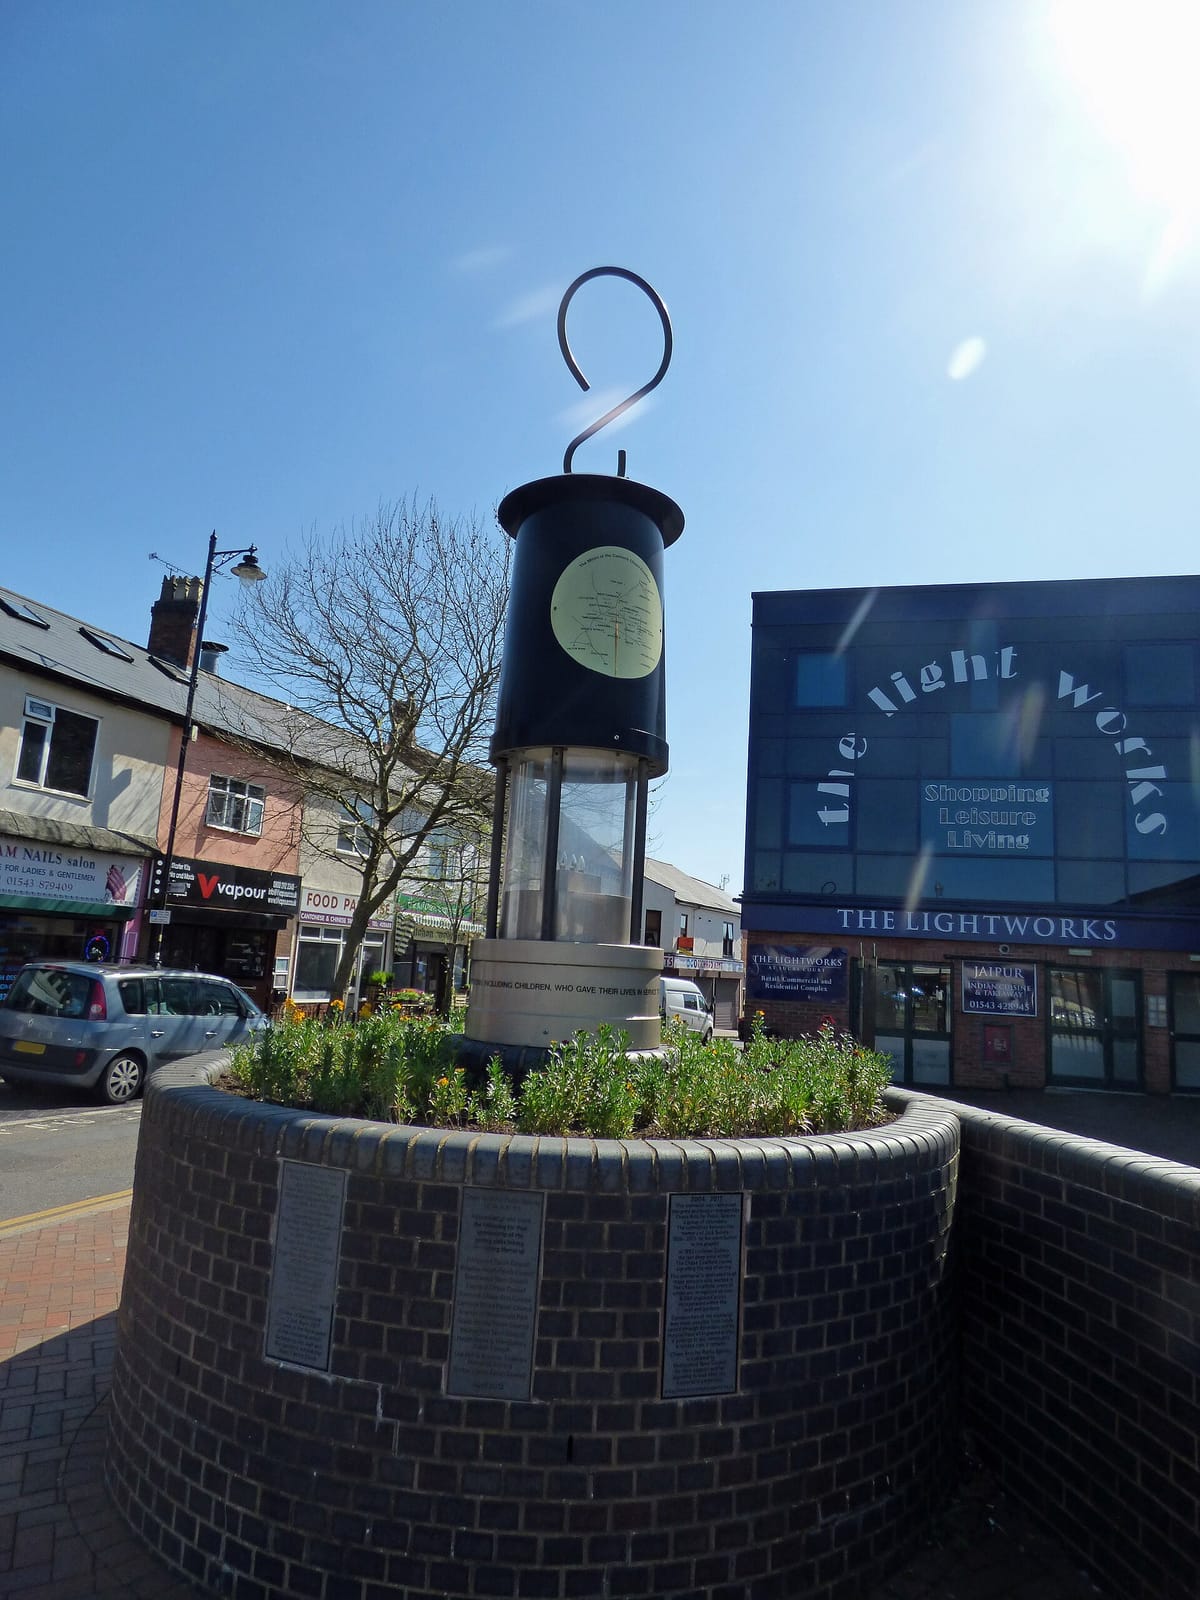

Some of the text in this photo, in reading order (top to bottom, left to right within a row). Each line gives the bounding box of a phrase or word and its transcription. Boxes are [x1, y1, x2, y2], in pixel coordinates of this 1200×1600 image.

[867, 646, 1018, 718] light
[1058, 669, 1168, 837] works
[925, 783, 1050, 804] Shopping
[939, 807, 1037, 826] Leisure
[947, 831, 1030, 850] Living
[23, 847, 63, 865] NAILS
[67, 856, 96, 870] salon
[4, 864, 20, 873] FOR
[21, 866, 46, 876] LADIES
[57, 870, 96, 882] GENTLEMEN
[6, 876, 35, 888] 01543
[217, 882, 267, 900] vapour
[306, 893, 338, 909] FOOD
[837, 908, 1117, 941] THE LIGHTWORKS
[752, 955, 842, 967] THE LIGHTWORKS
[975, 966, 1025, 979] JAIPUR
[515, 982, 552, 991] CHILDREN,
[554, 984, 574, 992] WHO
[575, 985, 597, 994] GAVE
[598, 986, 618, 995] THEIR
[765, 983, 828, 993] Residential Complex
[782, 977, 819, 985] Commercial
[968, 982, 997, 990] INDIAN
[969, 1000, 995, 1009] 01543
